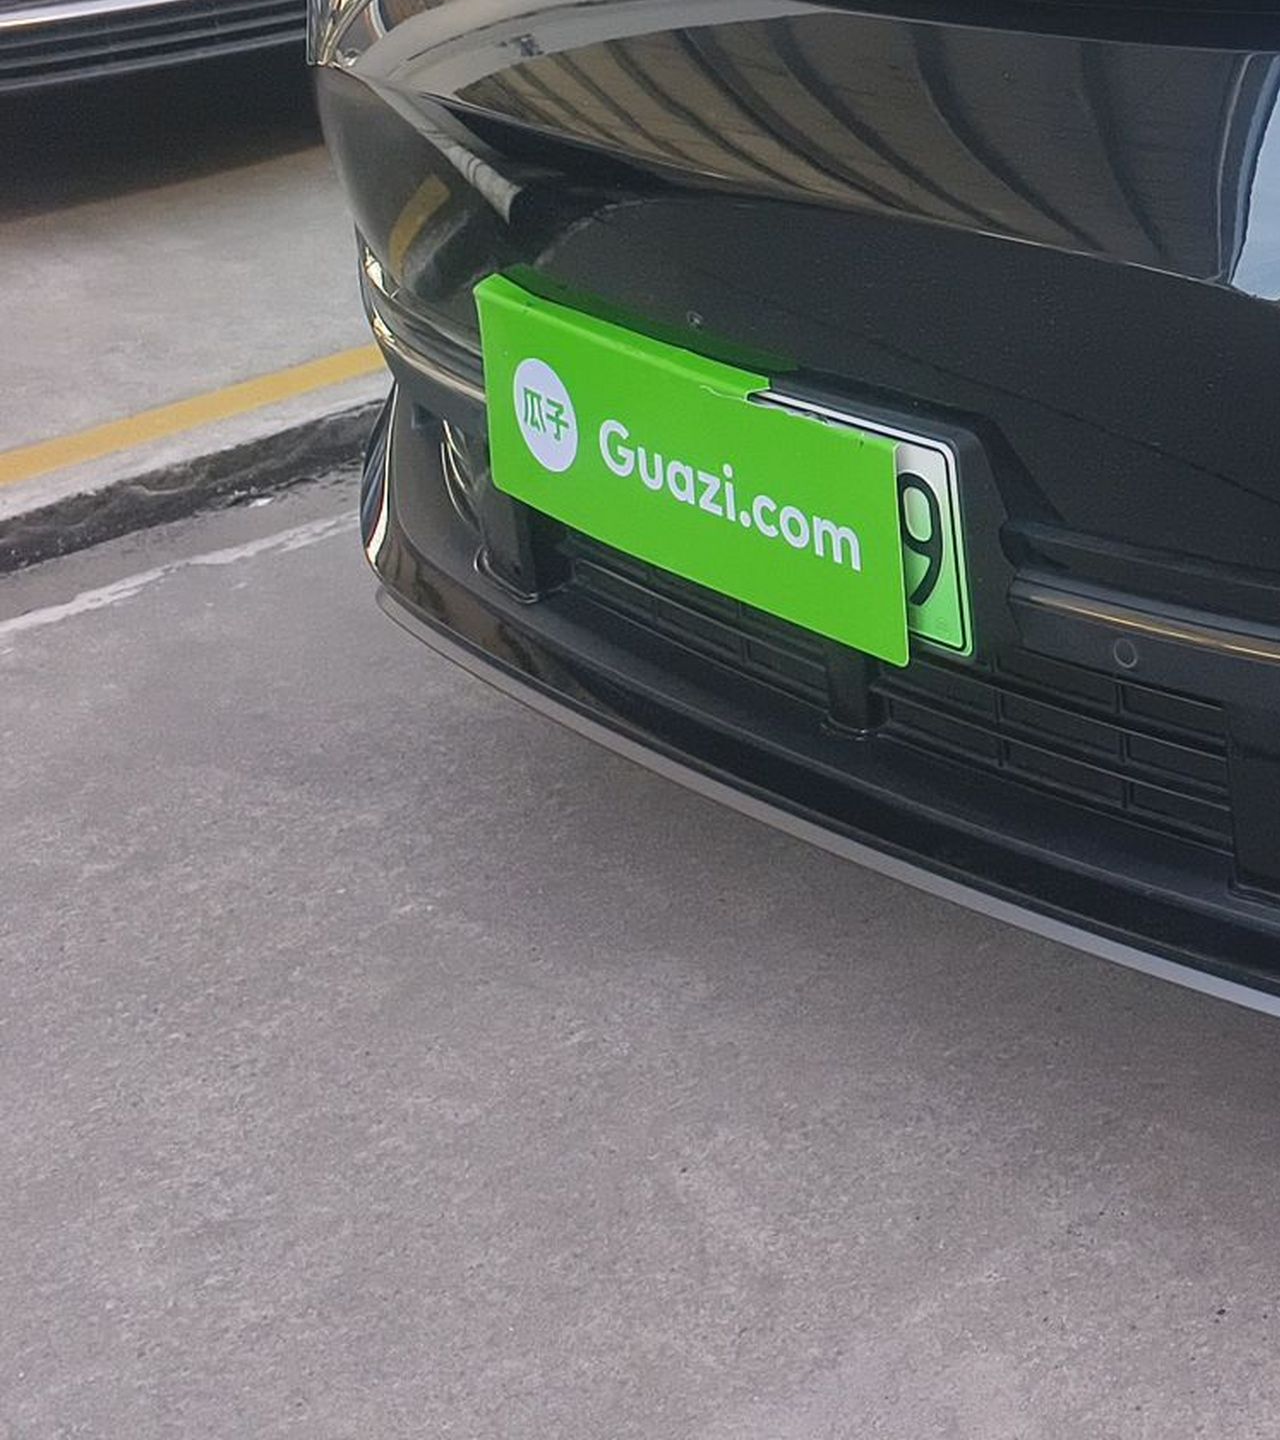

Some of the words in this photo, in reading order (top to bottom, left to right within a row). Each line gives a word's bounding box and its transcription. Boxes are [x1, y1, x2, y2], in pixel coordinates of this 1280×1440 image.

[521, 386, 571, 444] 瓜子
[599, 418, 863, 573] Guazi.com
[898, 471, 944, 607] 9
